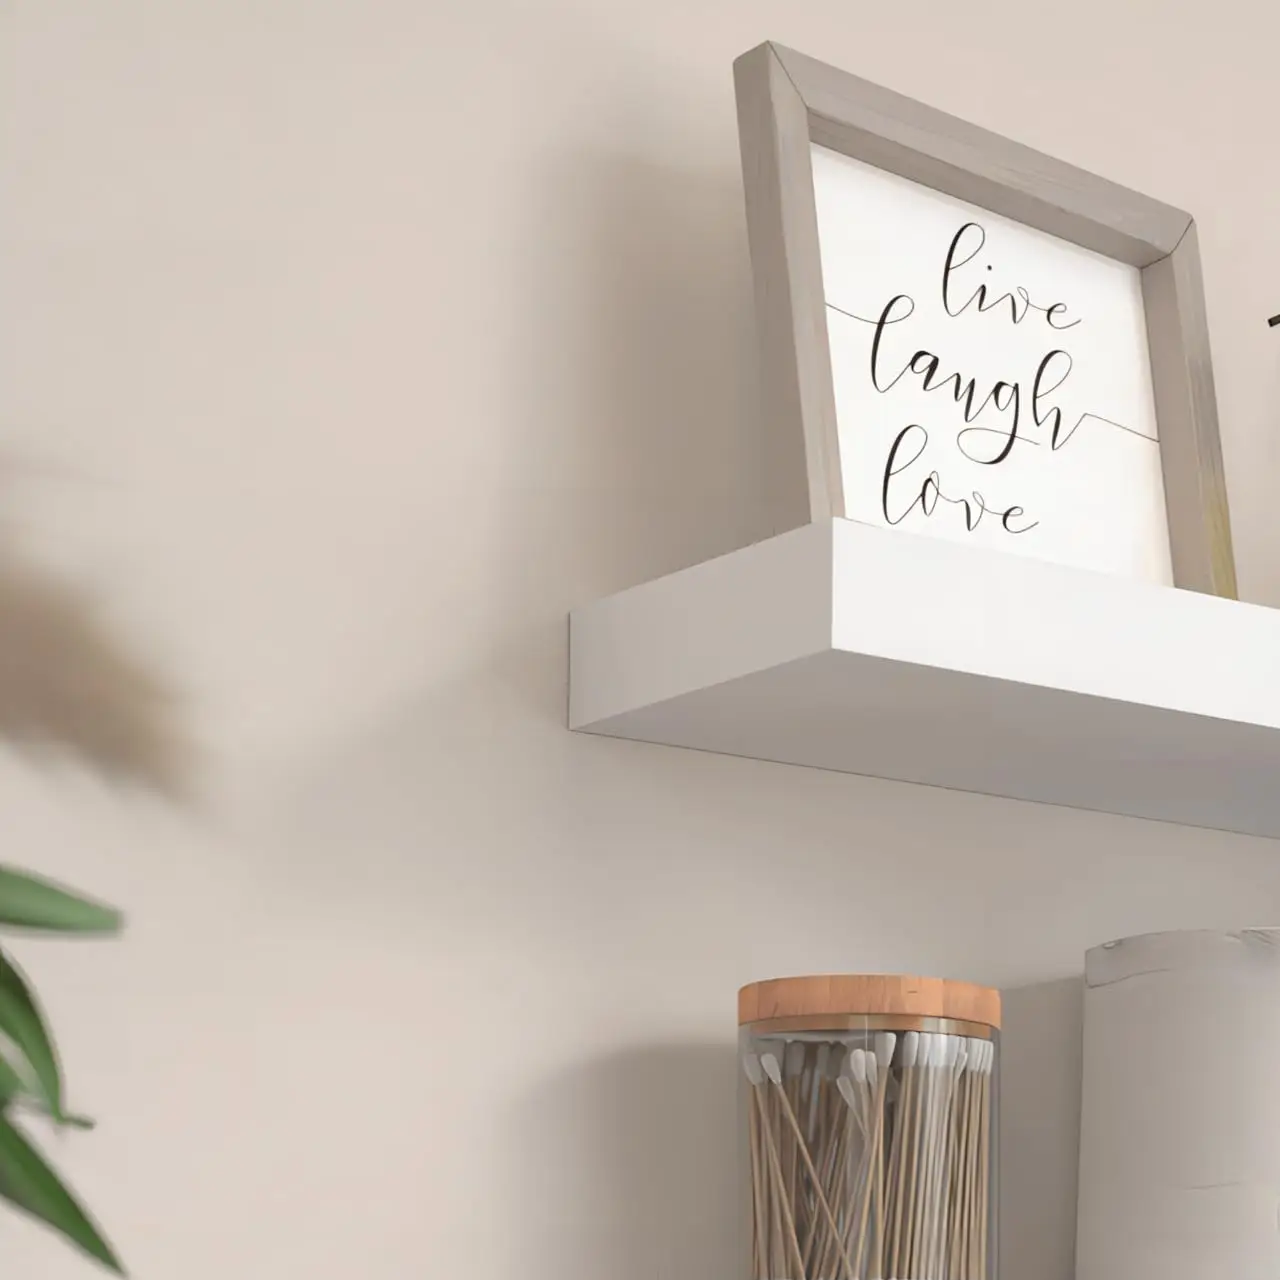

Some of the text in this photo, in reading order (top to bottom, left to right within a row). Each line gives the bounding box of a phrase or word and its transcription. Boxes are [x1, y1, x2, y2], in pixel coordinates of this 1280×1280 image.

[942, 222, 1082, 329] live
[825, 295, 1159, 464] laugh
[882, 425, 1039, 533] love
